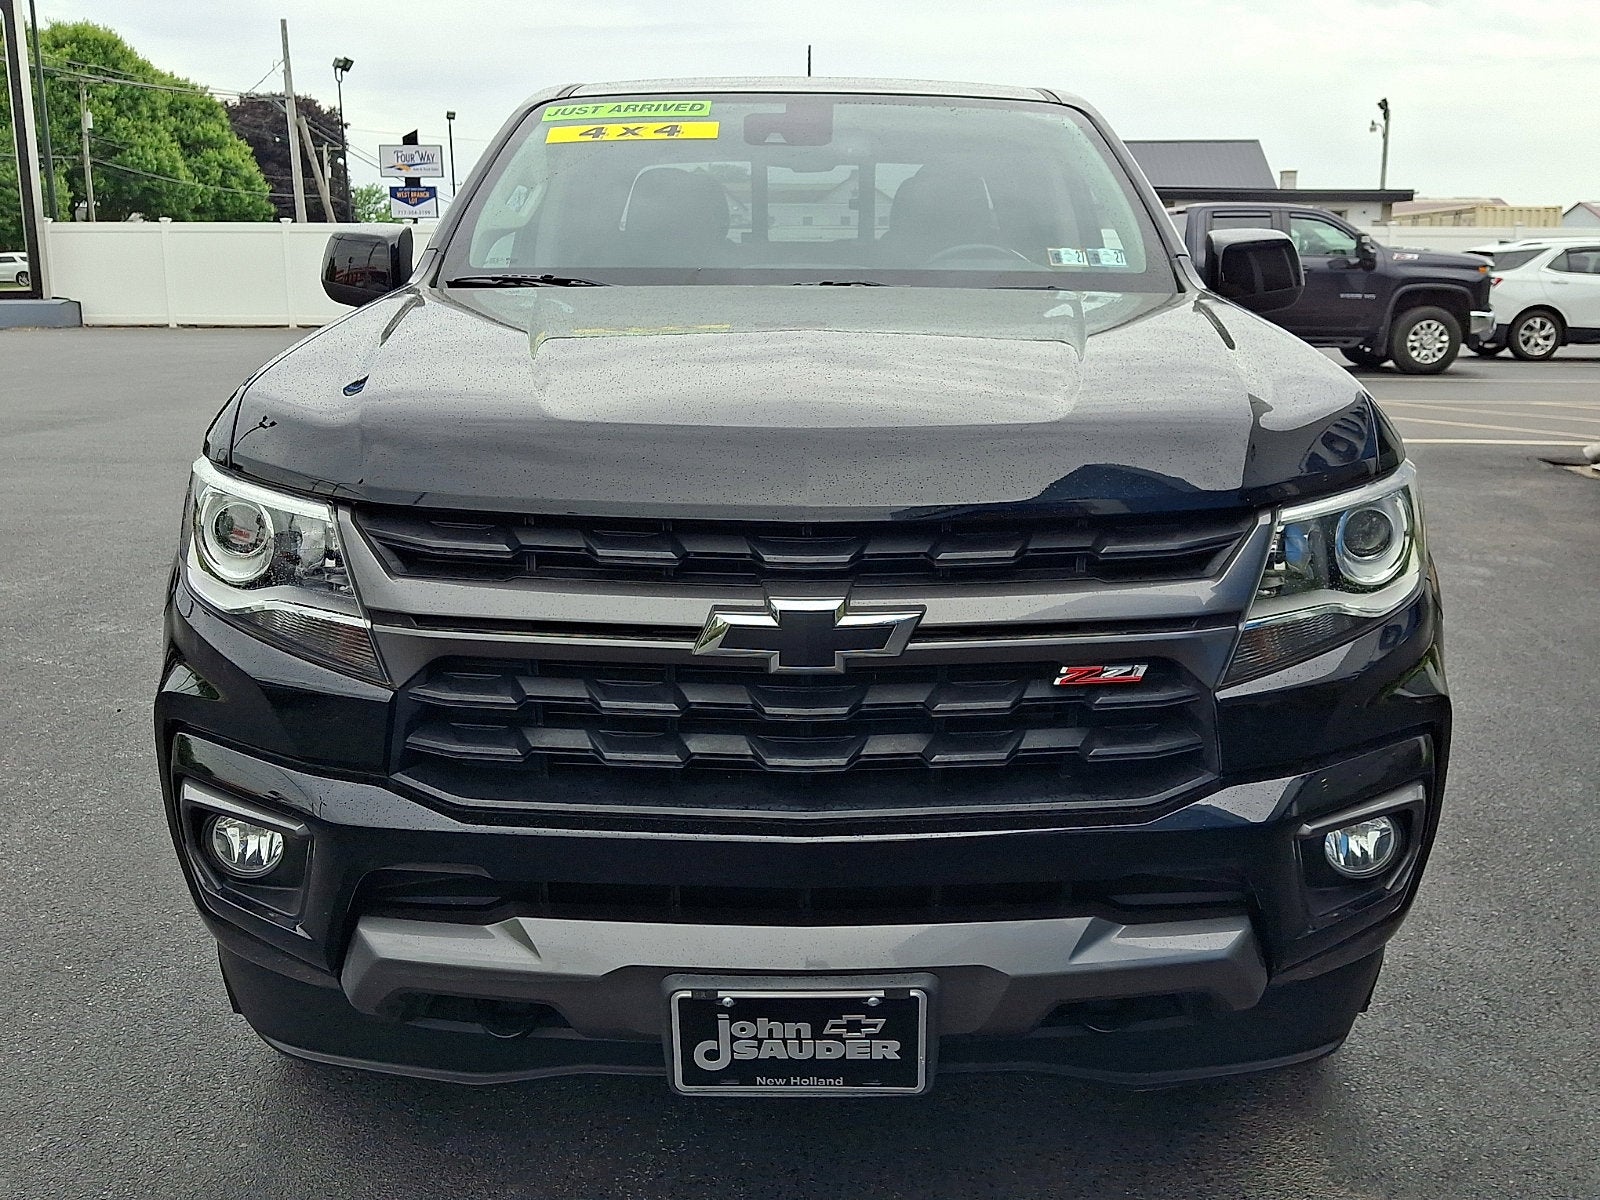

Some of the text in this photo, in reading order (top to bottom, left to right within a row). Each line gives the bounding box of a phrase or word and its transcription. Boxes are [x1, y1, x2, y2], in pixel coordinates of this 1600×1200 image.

[547, 103, 705, 117] JUST ARRIVED
[694, 1013, 812, 1071] john
[732, 1039, 901, 1060] SAUDER
[756, 1076, 844, 1086] New Holland
